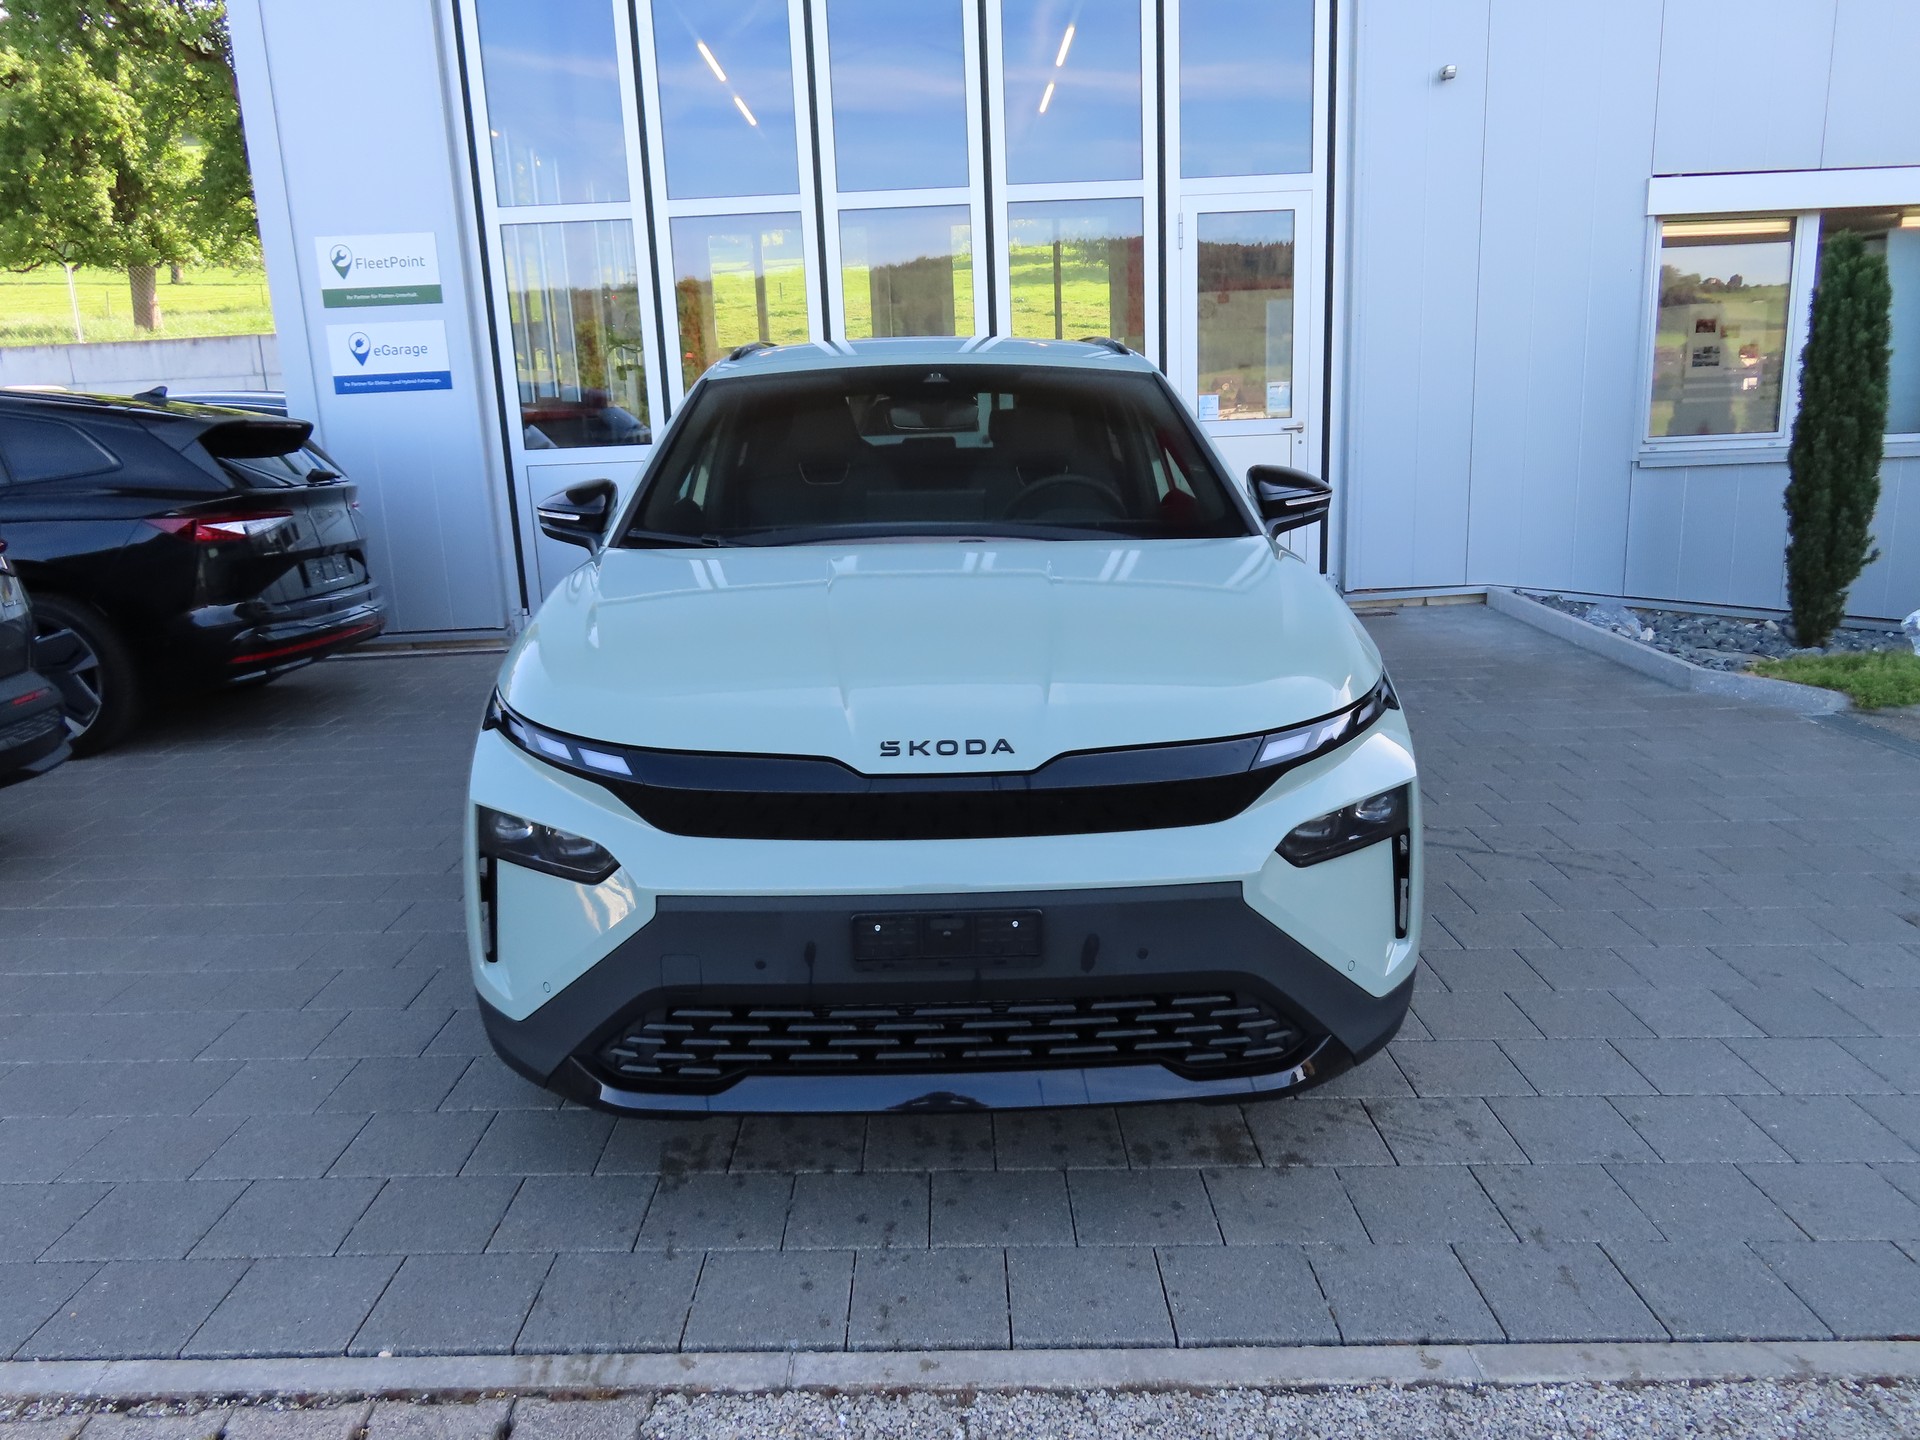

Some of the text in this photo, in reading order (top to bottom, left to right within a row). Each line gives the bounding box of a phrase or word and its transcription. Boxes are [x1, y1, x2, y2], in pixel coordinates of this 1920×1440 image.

[355, 256, 426, 270] FleetPoint
[373, 344, 428, 357] eGarage
[879, 738, 1015, 757] SKODA
